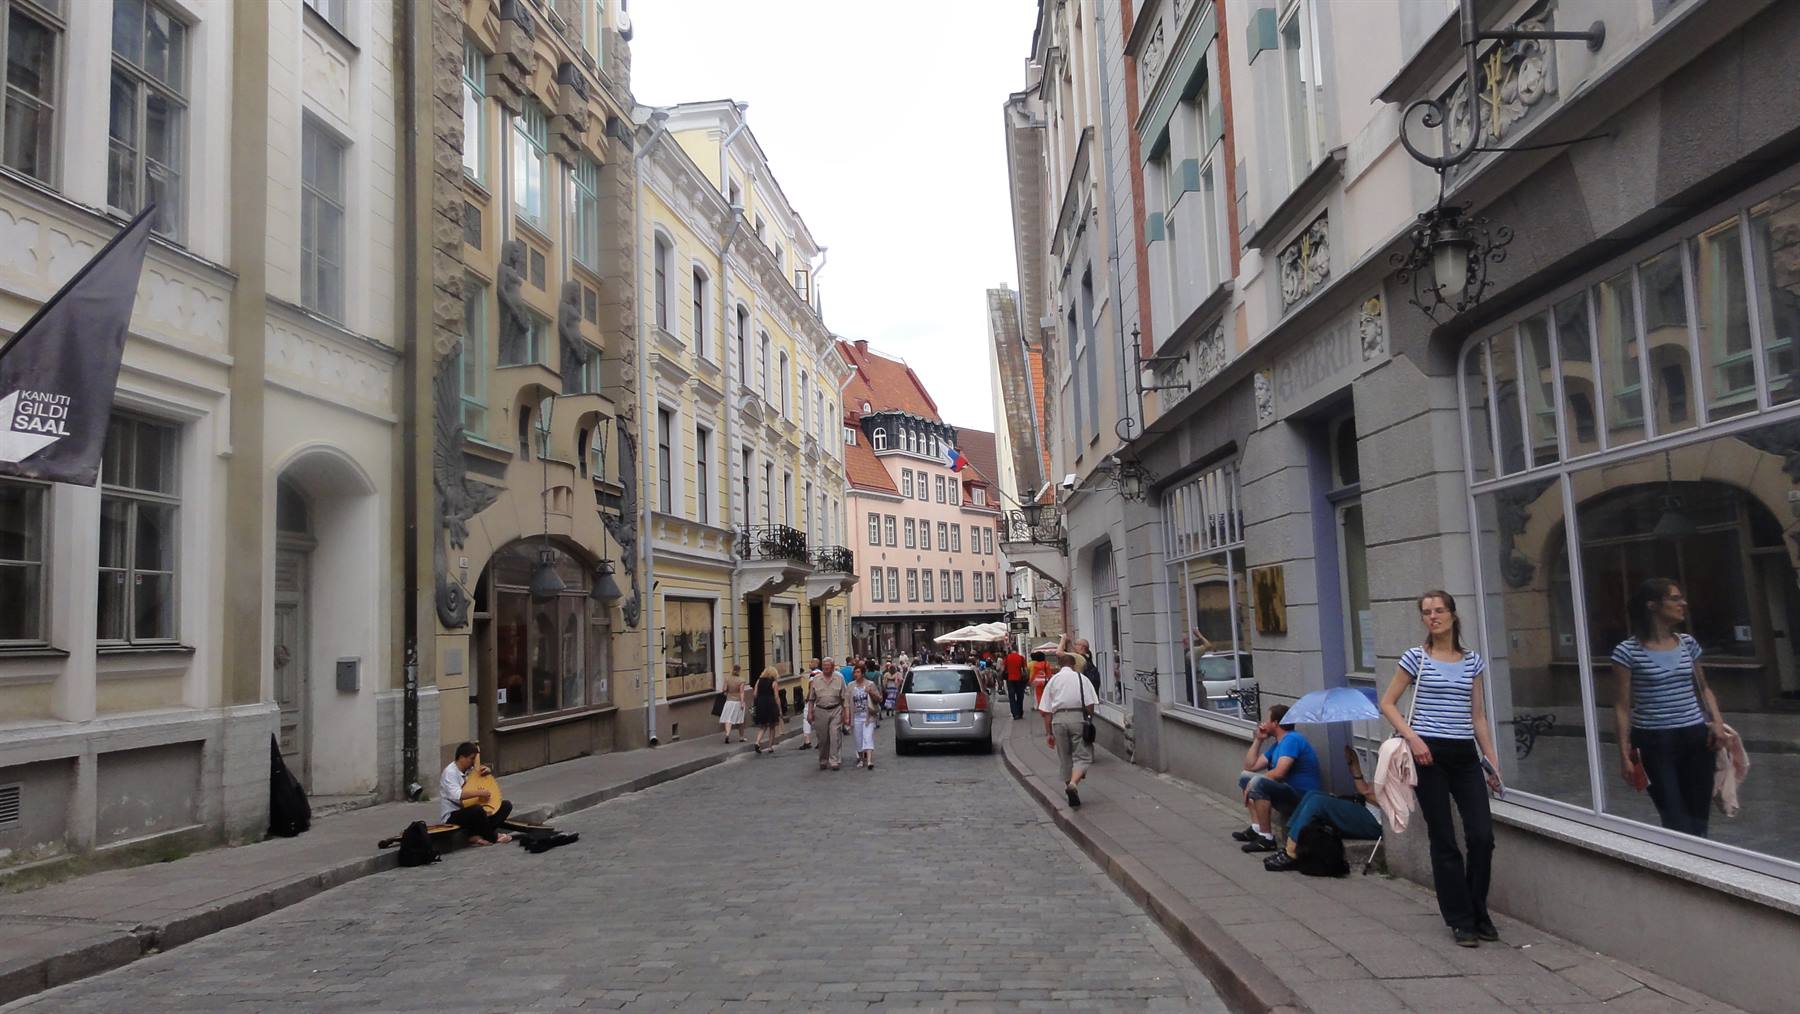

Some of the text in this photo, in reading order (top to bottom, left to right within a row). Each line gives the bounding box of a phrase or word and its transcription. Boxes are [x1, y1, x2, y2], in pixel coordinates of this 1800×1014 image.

[21, 390, 71, 406] KANUTI
[18, 401, 68, 419] GILDI
[14, 415, 71, 436] SAAL
